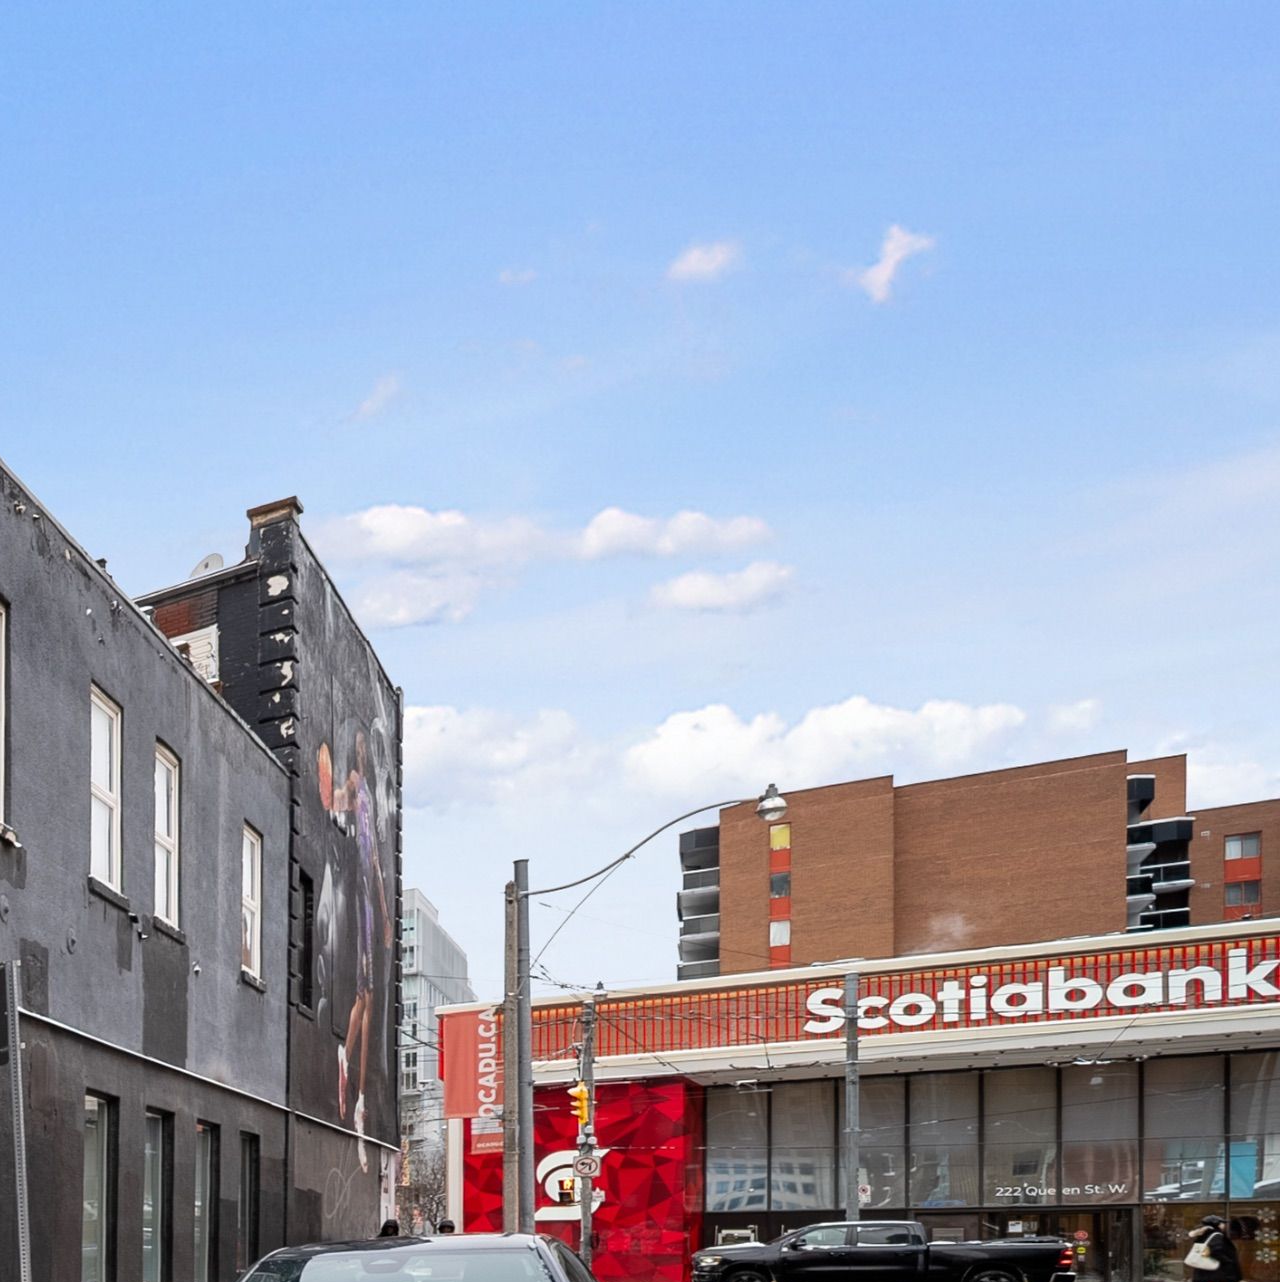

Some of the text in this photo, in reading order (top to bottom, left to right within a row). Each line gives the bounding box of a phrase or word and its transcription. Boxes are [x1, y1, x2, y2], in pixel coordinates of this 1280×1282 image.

[803, 948, 1280, 1034] Scotiabank
[995, 1186, 1022, 1197] 222
[1084, 1184, 1105, 1195] St.
[1108, 1183, 1129, 1194] W.
